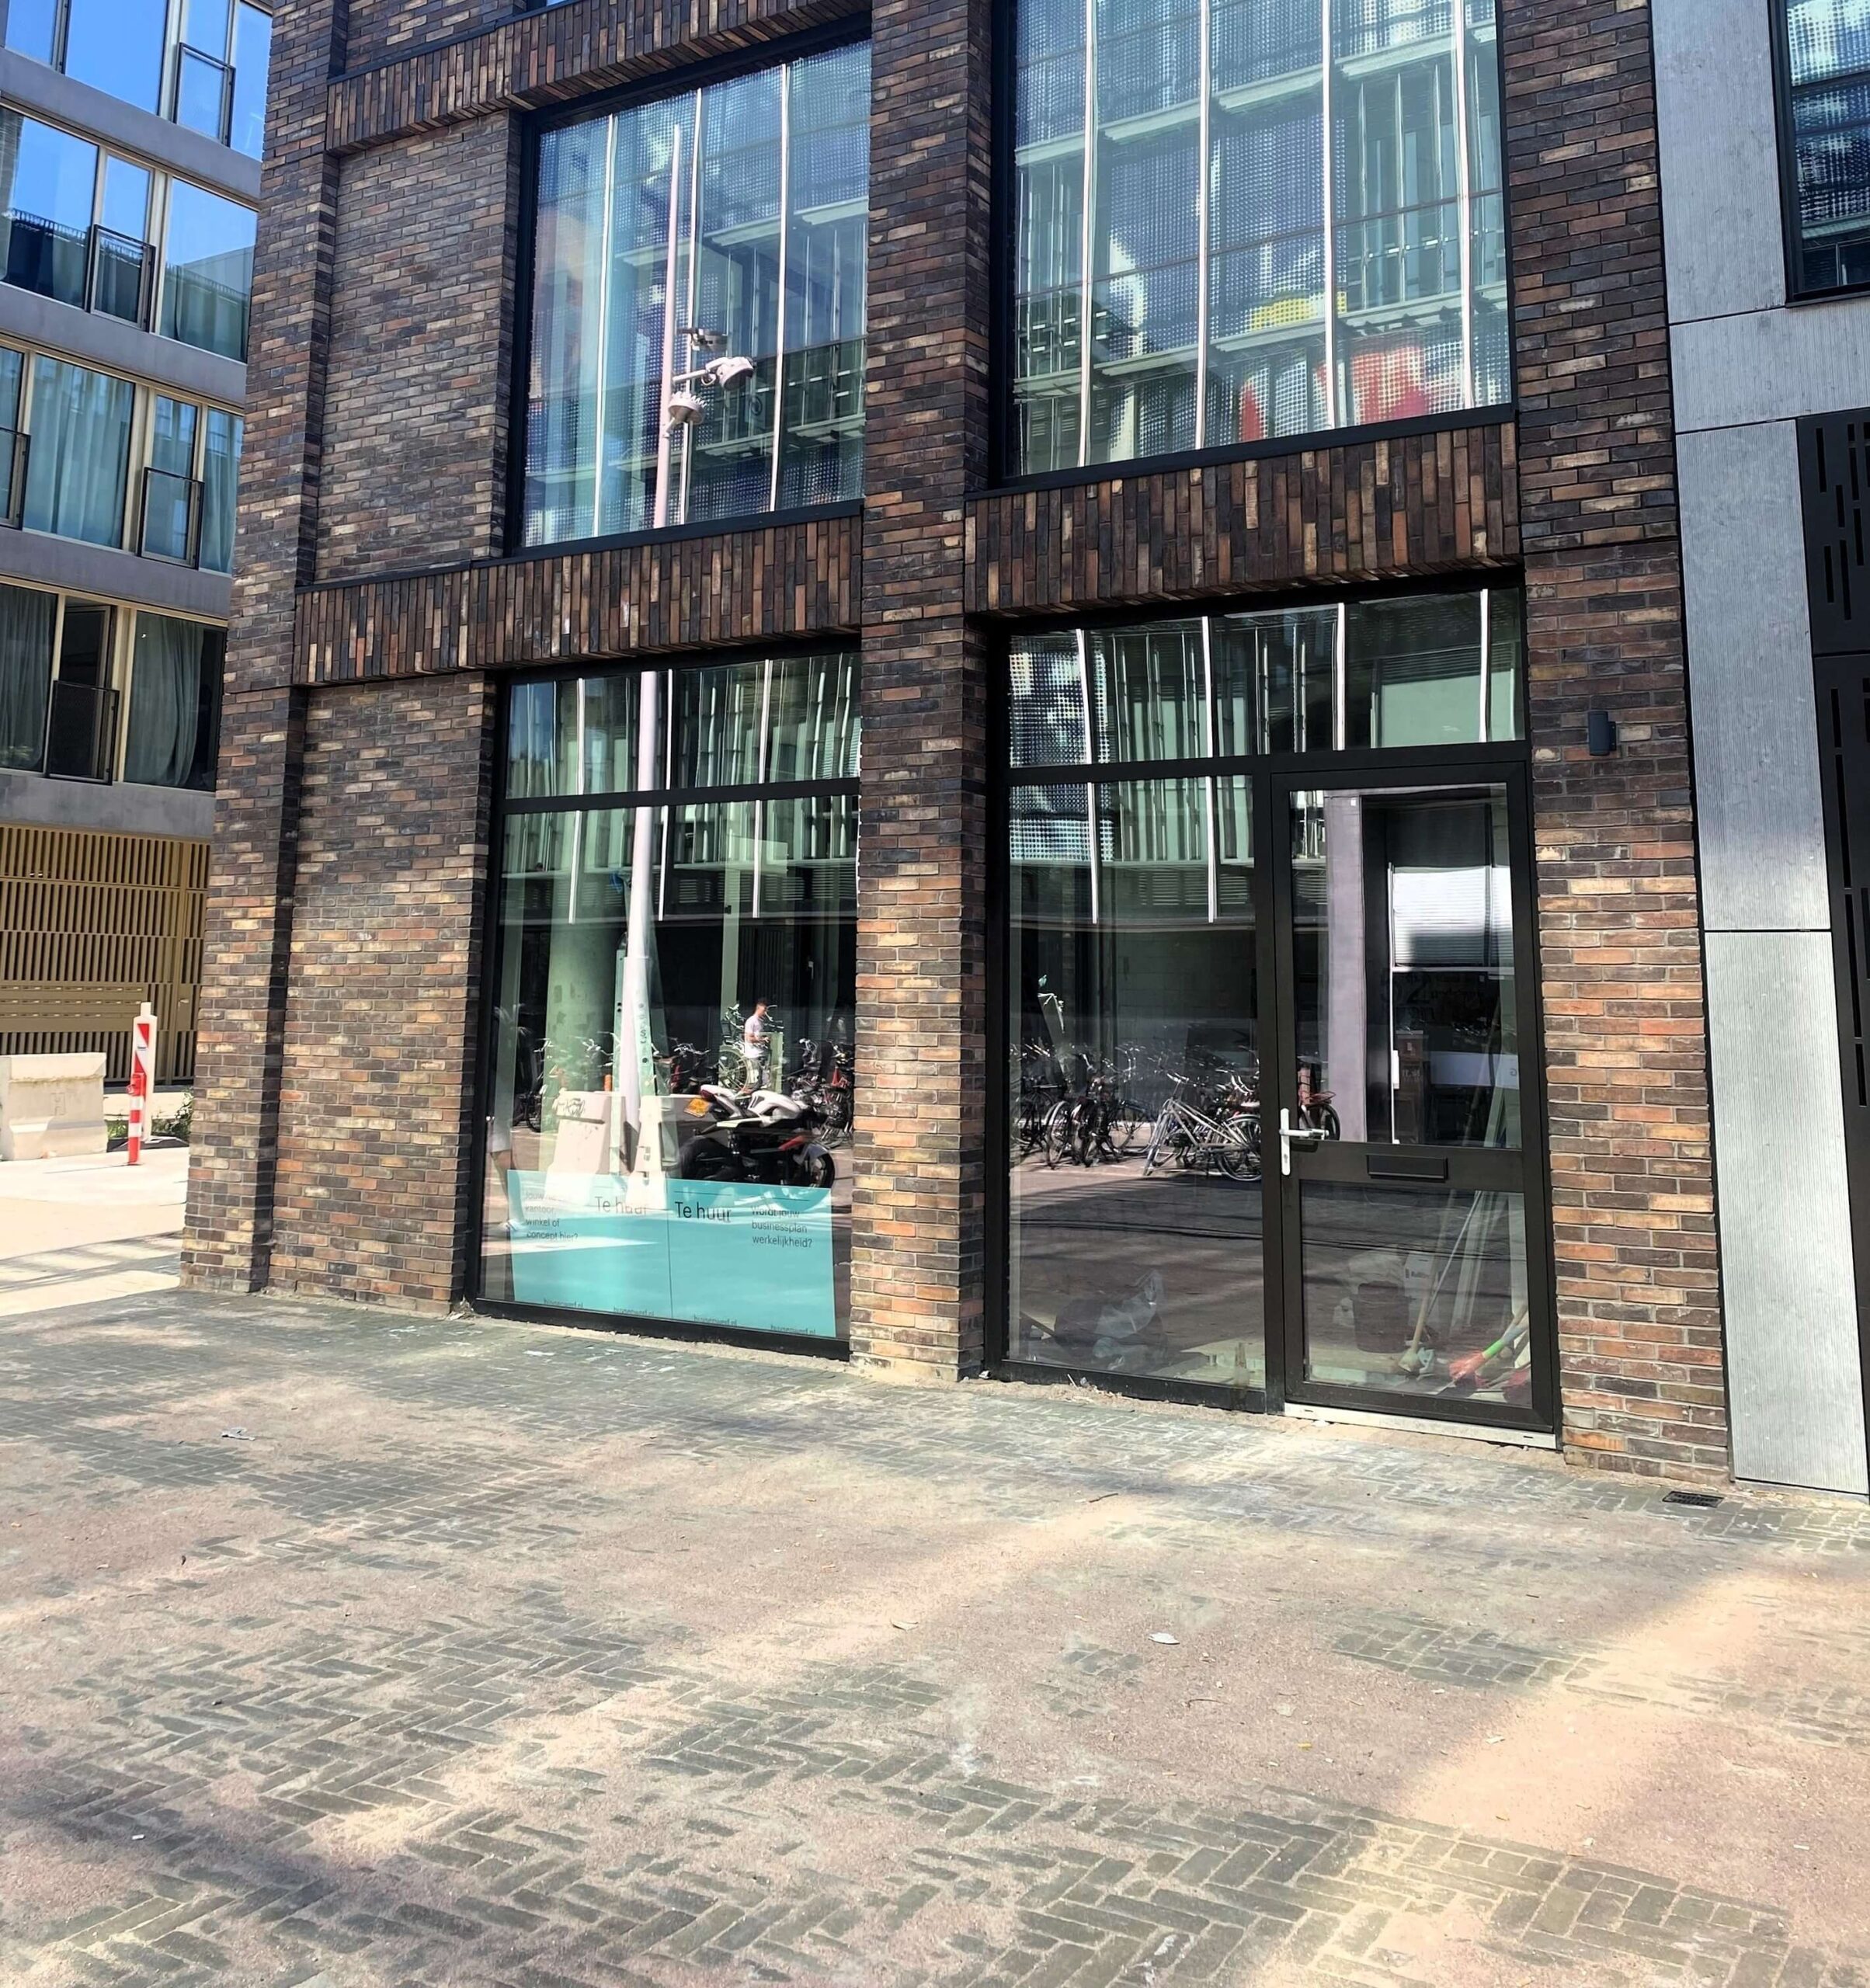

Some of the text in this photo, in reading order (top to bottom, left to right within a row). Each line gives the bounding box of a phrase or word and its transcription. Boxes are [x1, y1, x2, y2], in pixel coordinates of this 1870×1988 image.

[594, 1196, 611, 1212] Te
[674, 1201, 732, 1222] Te huur
[525, 1218, 560, 1227] winkel of
[752, 1221, 808, 1233] businessplan
[527, 1231, 558, 1241] concept
[752, 1234, 813, 1248] werkelijkheid?
